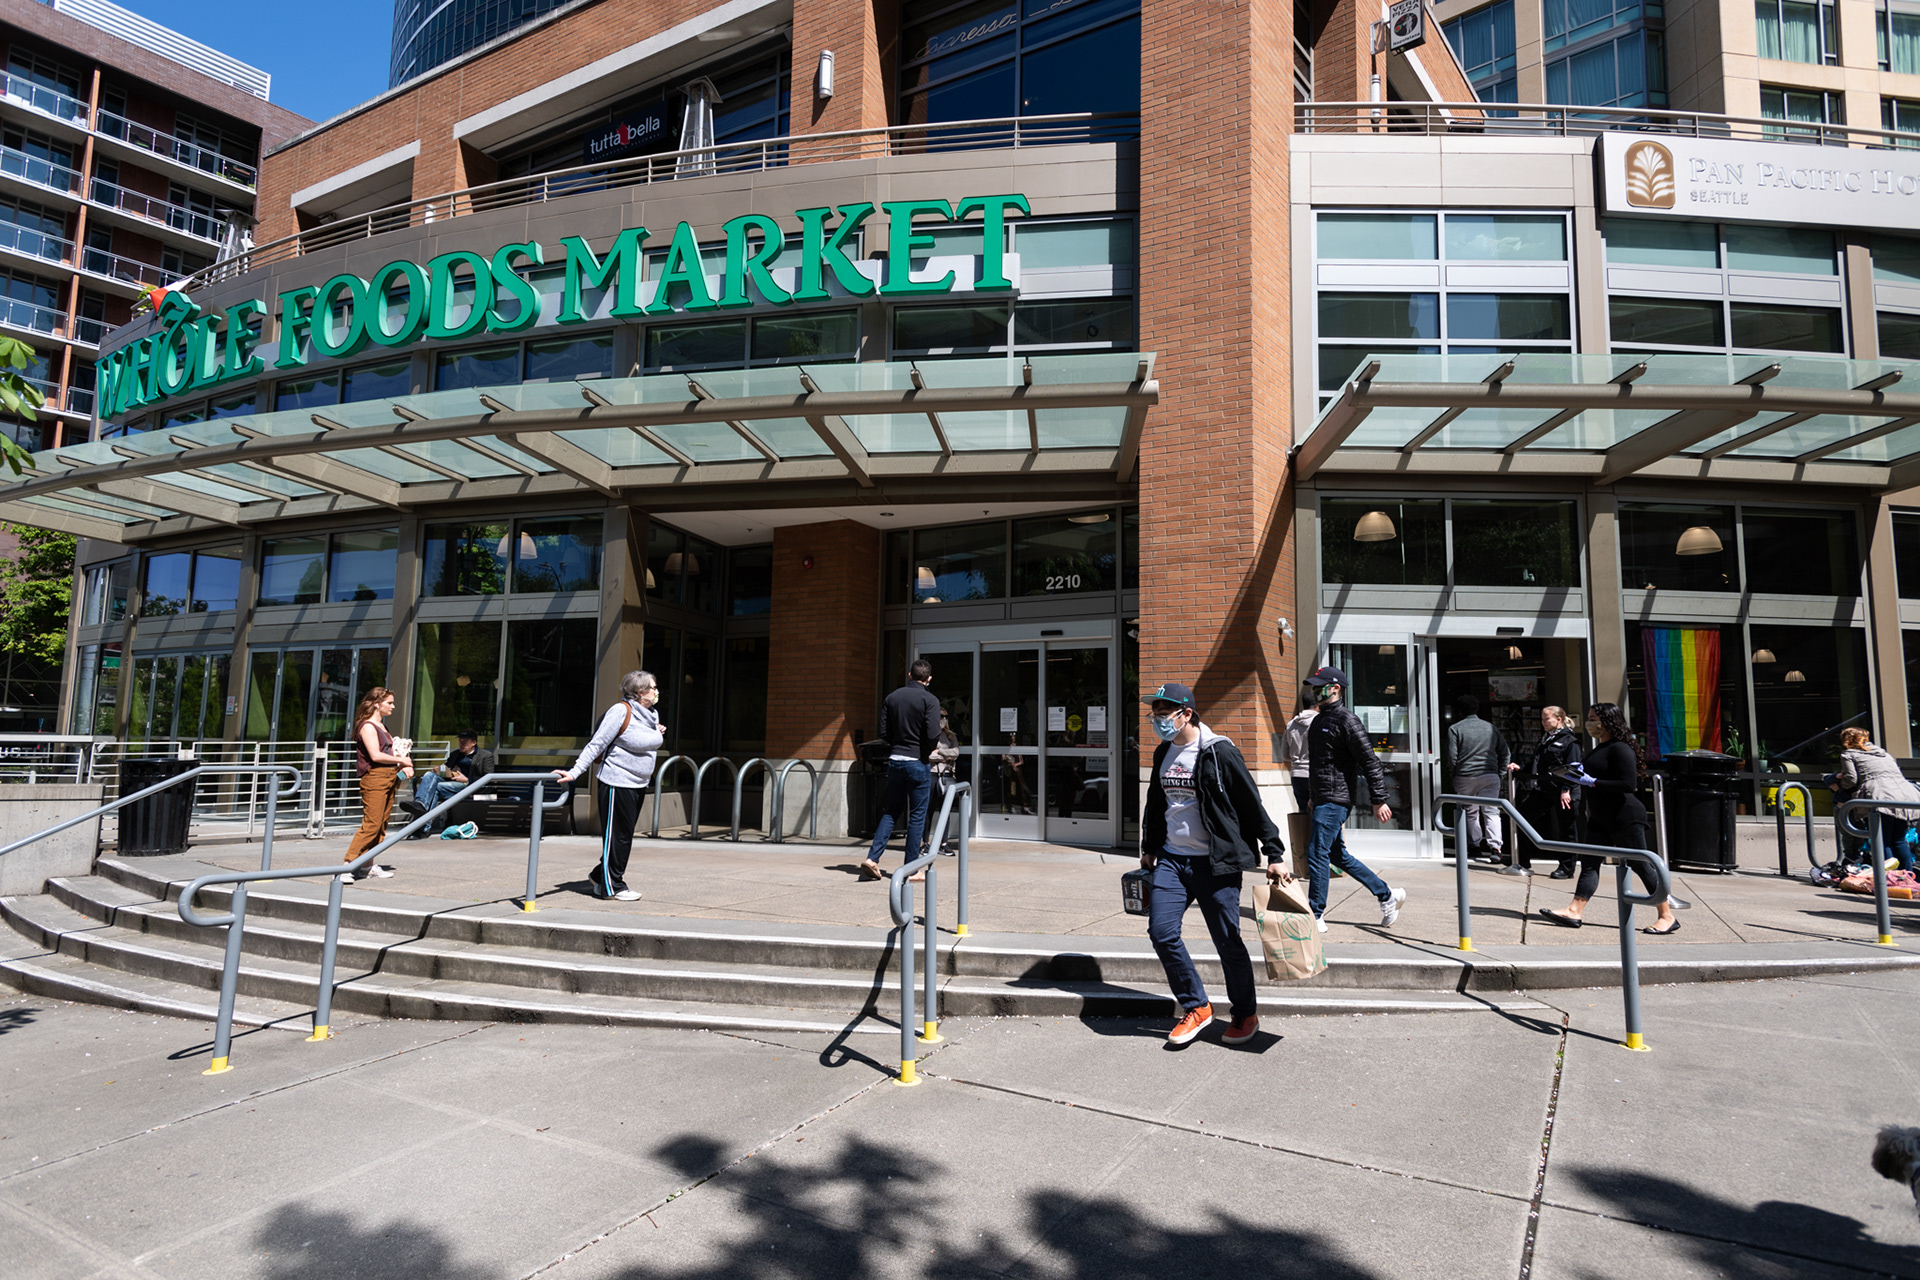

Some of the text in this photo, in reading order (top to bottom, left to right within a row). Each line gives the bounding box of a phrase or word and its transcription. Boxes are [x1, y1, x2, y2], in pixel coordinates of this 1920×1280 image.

[1392, 3, 1419, 18] PIZZA
[914, 13, 1017, 60] Espresso
[590, 131, 621, 154] tutta
[627, 115, 660, 140] bella
[1689, 157, 1920, 196] PAN PACIFIC HO
[1689, 189, 1749, 206] SEATTLE
[94, 193, 1032, 420] WHOLE FOODS MARKET
[1045, 574, 1081, 590] 2210
